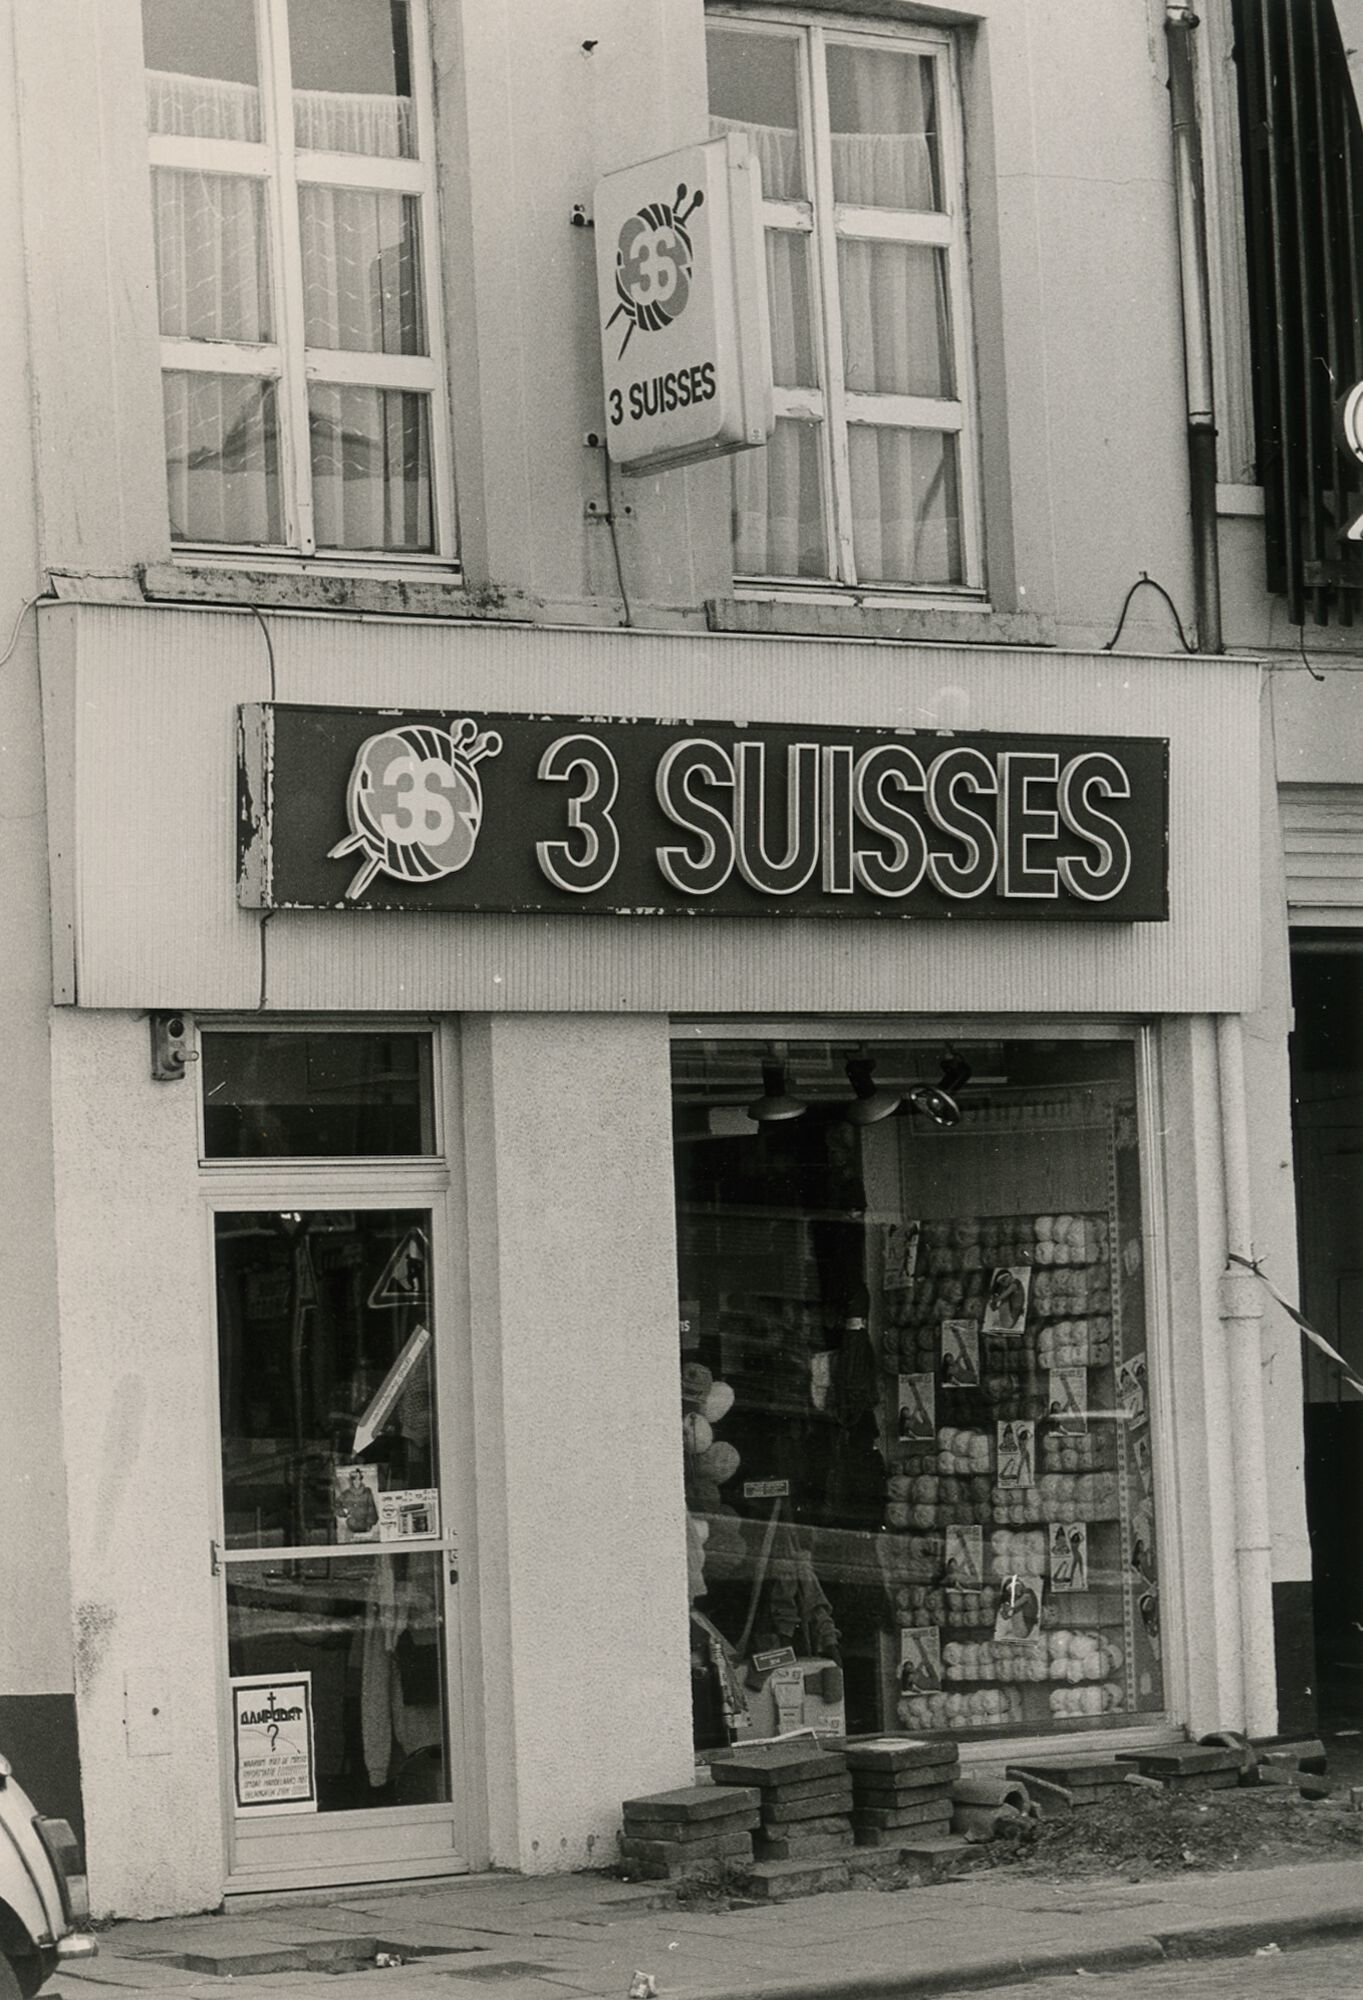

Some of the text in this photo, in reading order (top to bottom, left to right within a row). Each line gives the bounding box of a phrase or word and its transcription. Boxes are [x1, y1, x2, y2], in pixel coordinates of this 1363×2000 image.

[608, 361, 716, 426] 3 SUISSES
[535, 733, 1132, 903] 3 SUISSES
[266, 1723, 280, 1753] ?
